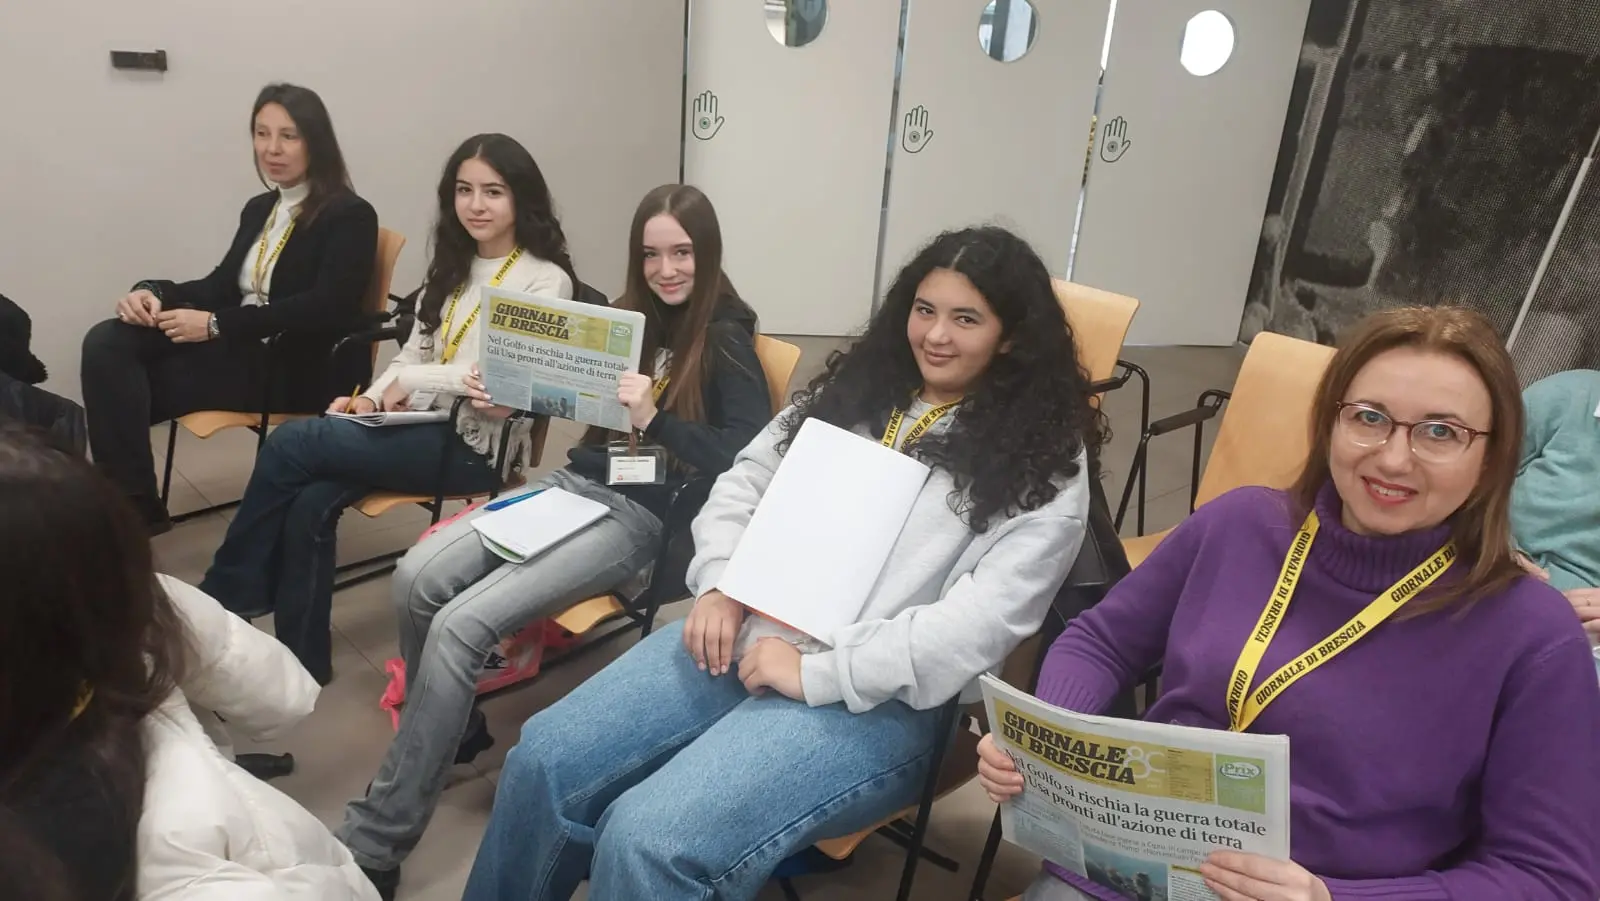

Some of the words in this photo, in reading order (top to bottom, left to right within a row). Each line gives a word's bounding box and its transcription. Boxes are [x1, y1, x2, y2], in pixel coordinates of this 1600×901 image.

[490, 313, 507, 327] DI
[509, 319, 569, 340] BRESCIA
[495, 302, 568, 327] GIORNALE
[487, 346, 500, 356] Gli
[501, 349, 516, 359] Usa
[517, 353, 544, 366] pronti
[545, 358, 584, 374] all'azione
[585, 365, 595, 376] di
[596, 369, 618, 381] terra
[488, 335, 501, 346] Nel
[503, 338, 527, 351] Golfo
[528, 343, 535, 352] si
[535, 345, 564, 357] rischia
[565, 351, 573, 361] la
[575, 355, 602, 367] guerra
[1282, 532, 1311, 586] GIORNALE
[1391, 556, 1445, 603] GIORNALE
[1443, 546, 1456, 563] DI
[1277, 586, 1289, 600] DI
[1255, 600, 1284, 644] BRESCIA
[1255, 661, 1306, 705] GIORNALE
[1304, 652, 1319, 667] DI
[1318, 620, 1366, 657] BRESCIA
[1002, 722, 1024, 745] DI
[1028, 736, 1136, 785] BRESCIA
[1004, 710, 1128, 764] GIORNALE
[1224, 762, 1256, 776] Prix
[1026, 763, 1062, 791] Golfo
[1064, 785, 1076, 798] si
[1078, 789, 1131, 814] rischia
[1135, 802, 1149, 817] la
[1153, 808, 1210, 827] guerra
[1215, 816, 1267, 836] totale
[1028, 774, 1050, 797] Usa
[1052, 792, 1094, 820] pronti
[1097, 812, 1176, 838] all'azione
[1179, 827, 1197, 841] di
[1201, 831, 1243, 850] terra
